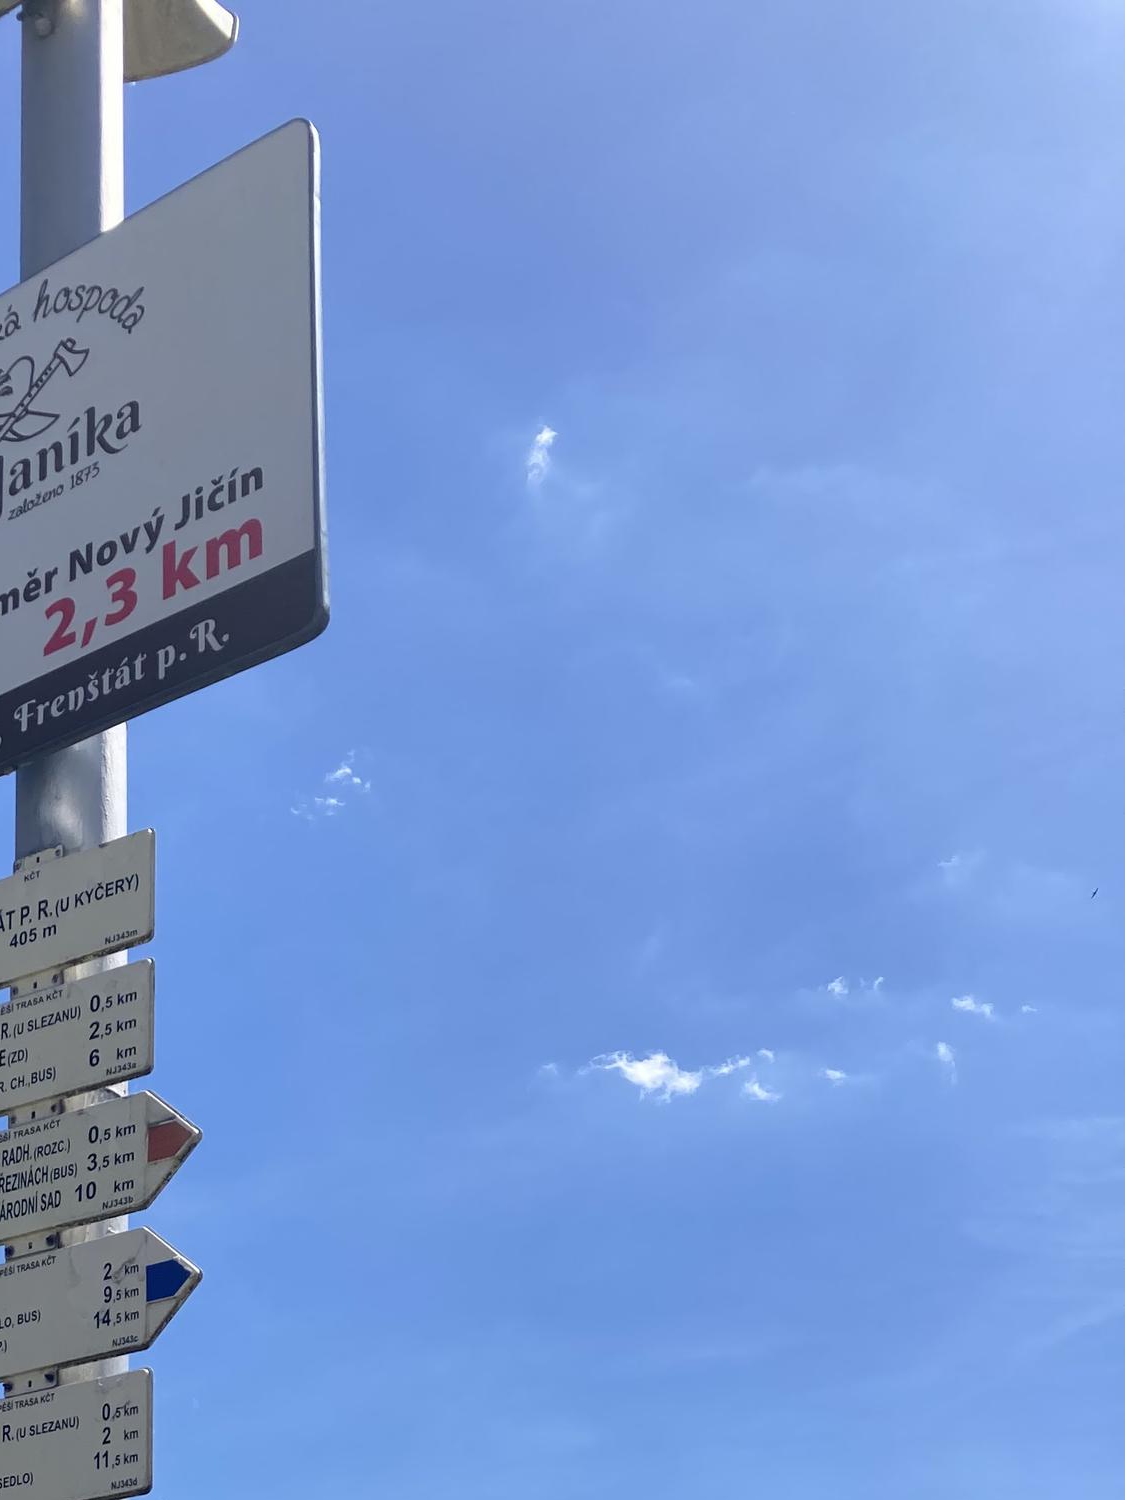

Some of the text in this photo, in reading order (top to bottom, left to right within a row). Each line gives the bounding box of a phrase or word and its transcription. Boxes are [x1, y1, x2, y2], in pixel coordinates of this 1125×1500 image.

[33, 278, 145, 334] hospoda
[7, 461, 100, 521] založeno 1873
[69, 506, 165, 582] Nový
[174, 465, 264, 532] Jičín
[43, 517, 263, 657] 2,3 km
[14, 651, 148, 733] Frenštát
[156, 642, 187, 679] p.
[189, 618, 230, 653] R.
[74, 873, 140, 908] KYČERY)
[9, 924, 57, 948] 405 m
[27, 1005, 82, 1034] SLEZANU)
[89, 994, 113, 1013] 0,5
[117, 990, 138, 1006] km
[8, 1048, 29, 1068] (ZD)
[89, 1021, 113, 1041] 2,5
[116, 1017, 137, 1033] km
[89, 1049, 100, 1067] 6
[116, 1045, 137, 1061] km
[2, 1144, 32, 1167] RADH.
[33, 1138, 71, 1161] (ROZC.)
[88, 1125, 111, 1144] 0,5
[115, 1123, 136, 1139] km
[50, 1162, 78, 1184] (BUS)
[86, 1153, 110, 1172] 3,5
[114, 1150, 135, 1167] km
[40, 1190, 61, 1211] SAD
[75, 1181, 97, 1202] 10
[113, 1178, 134, 1193] km
[103, 1262, 112, 1281] 2
[17, 1310, 41, 1325] BUS)
[103, 1286, 122, 1304] 9,5
[93, 1309, 122, 1329] 14,5
[29, 1415, 79, 1438] SLEZANU)
[102, 1403, 121, 1421] 0,5
[102, 1427, 111, 1445] 2
[94, 1450, 121, 1470] 11,5
